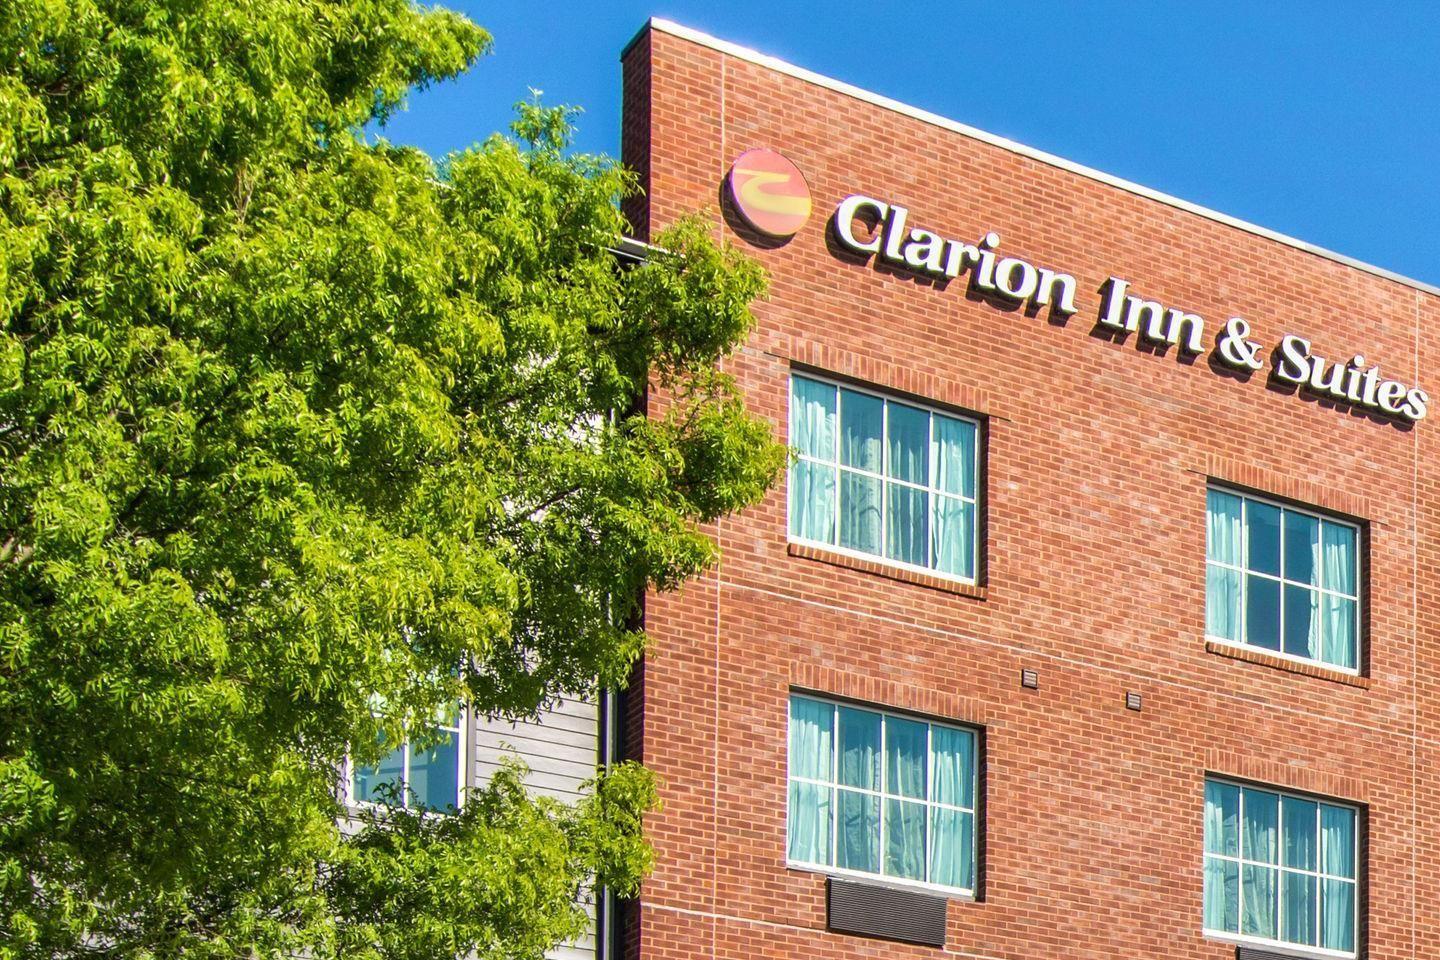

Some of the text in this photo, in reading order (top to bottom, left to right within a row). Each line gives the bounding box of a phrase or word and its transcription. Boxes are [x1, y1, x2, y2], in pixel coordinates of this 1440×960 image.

[836, 194, 1429, 421] Clarion Inn & Suites
